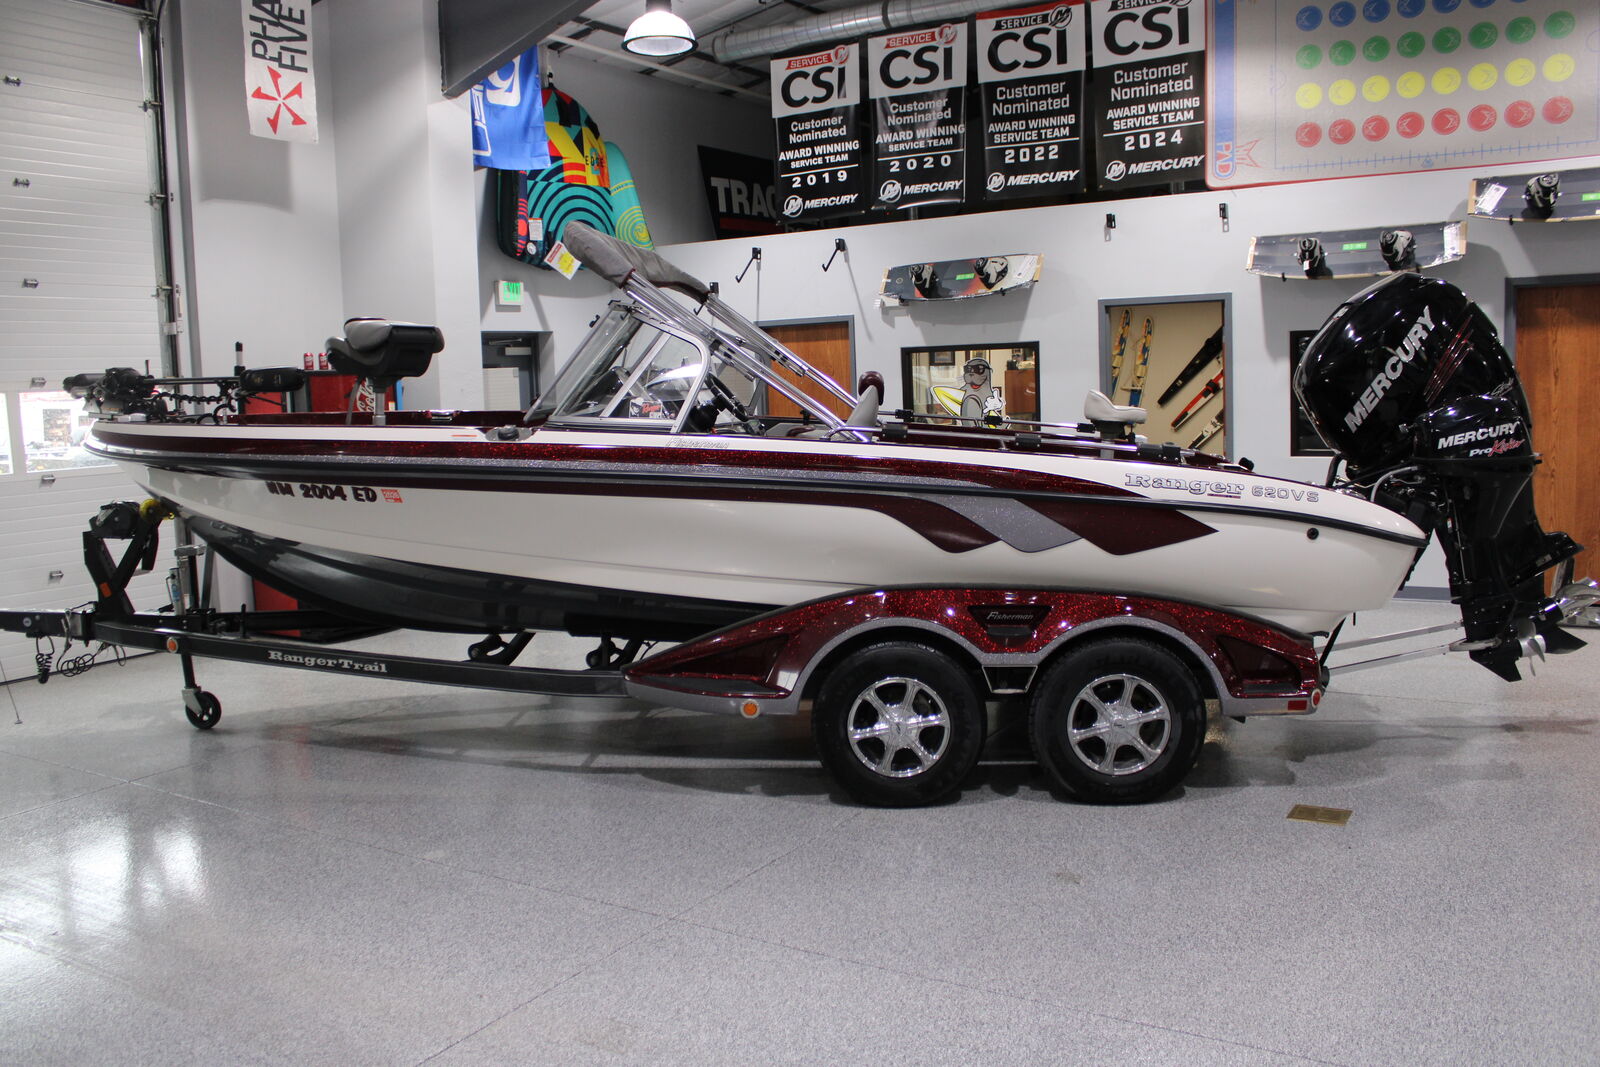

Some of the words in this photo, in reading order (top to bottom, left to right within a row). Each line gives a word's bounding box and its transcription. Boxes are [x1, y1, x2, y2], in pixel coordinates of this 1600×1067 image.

[1001, 16, 1042, 29] SERVICE
[278, 5, 308, 73] FIVE
[889, 32, 932, 47] SERVICE
[791, 55, 828, 69] SERVICE
[1114, 61, 1188, 85] Customer
[997, 81, 1066, 100] Customer
[1111, 75, 1193, 101] Nominated
[889, 98, 948, 114] Customer
[992, 94, 1069, 116] Nominated
[1106, 105, 1145, 120] AWARD
[1148, 97, 1200, 113] WINNING
[791, 115, 843, 132] Customer
[887, 108, 951, 126] Nominated
[988, 120, 1025, 133] AWARD
[1028, 114, 1075, 129] WINNING
[1113, 116, 1158, 131] SERVICE
[1161, 110, 1194, 124] TEAM
[789, 126, 847, 144] Nominated
[876, 130, 913, 144] AWARD
[916, 124, 965, 138] WINNING
[994, 130, 1038, 144] SERVICE
[1040, 127, 1070, 138] TEAM
[1124, 130, 1183, 151] 2024
[779, 147, 812, 161] AWARD
[814, 140, 859, 155] WINNING
[888, 141, 925, 152] SERVICE
[927, 138, 953, 148] TEAM
[1004, 145, 1058, 164] 2022
[790, 156, 823, 169] SERVICE
[825, 154, 848, 163] TEAM
[889, 155, 951, 172] 2020
[1128, 155, 1205, 174] MERCURY
[1216, 142, 1232, 175] PAD
[792, 170, 848, 187] 2019
[903, 180, 963, 195] MERCURY
[1007, 170, 1080, 186] MERCURY
[804, 193, 858, 209] MERCURY
[1343, 305, 1435, 433] MERCURY
[1437, 421, 1520, 449] MERCURY
[300, 483, 348, 501] 2004
[352, 486, 377, 502] ED
[1125, 472, 1244, 495] Ranger
[1251, 485, 1319, 502] 620VS
[987, 611, 1034, 620] Fisherman
